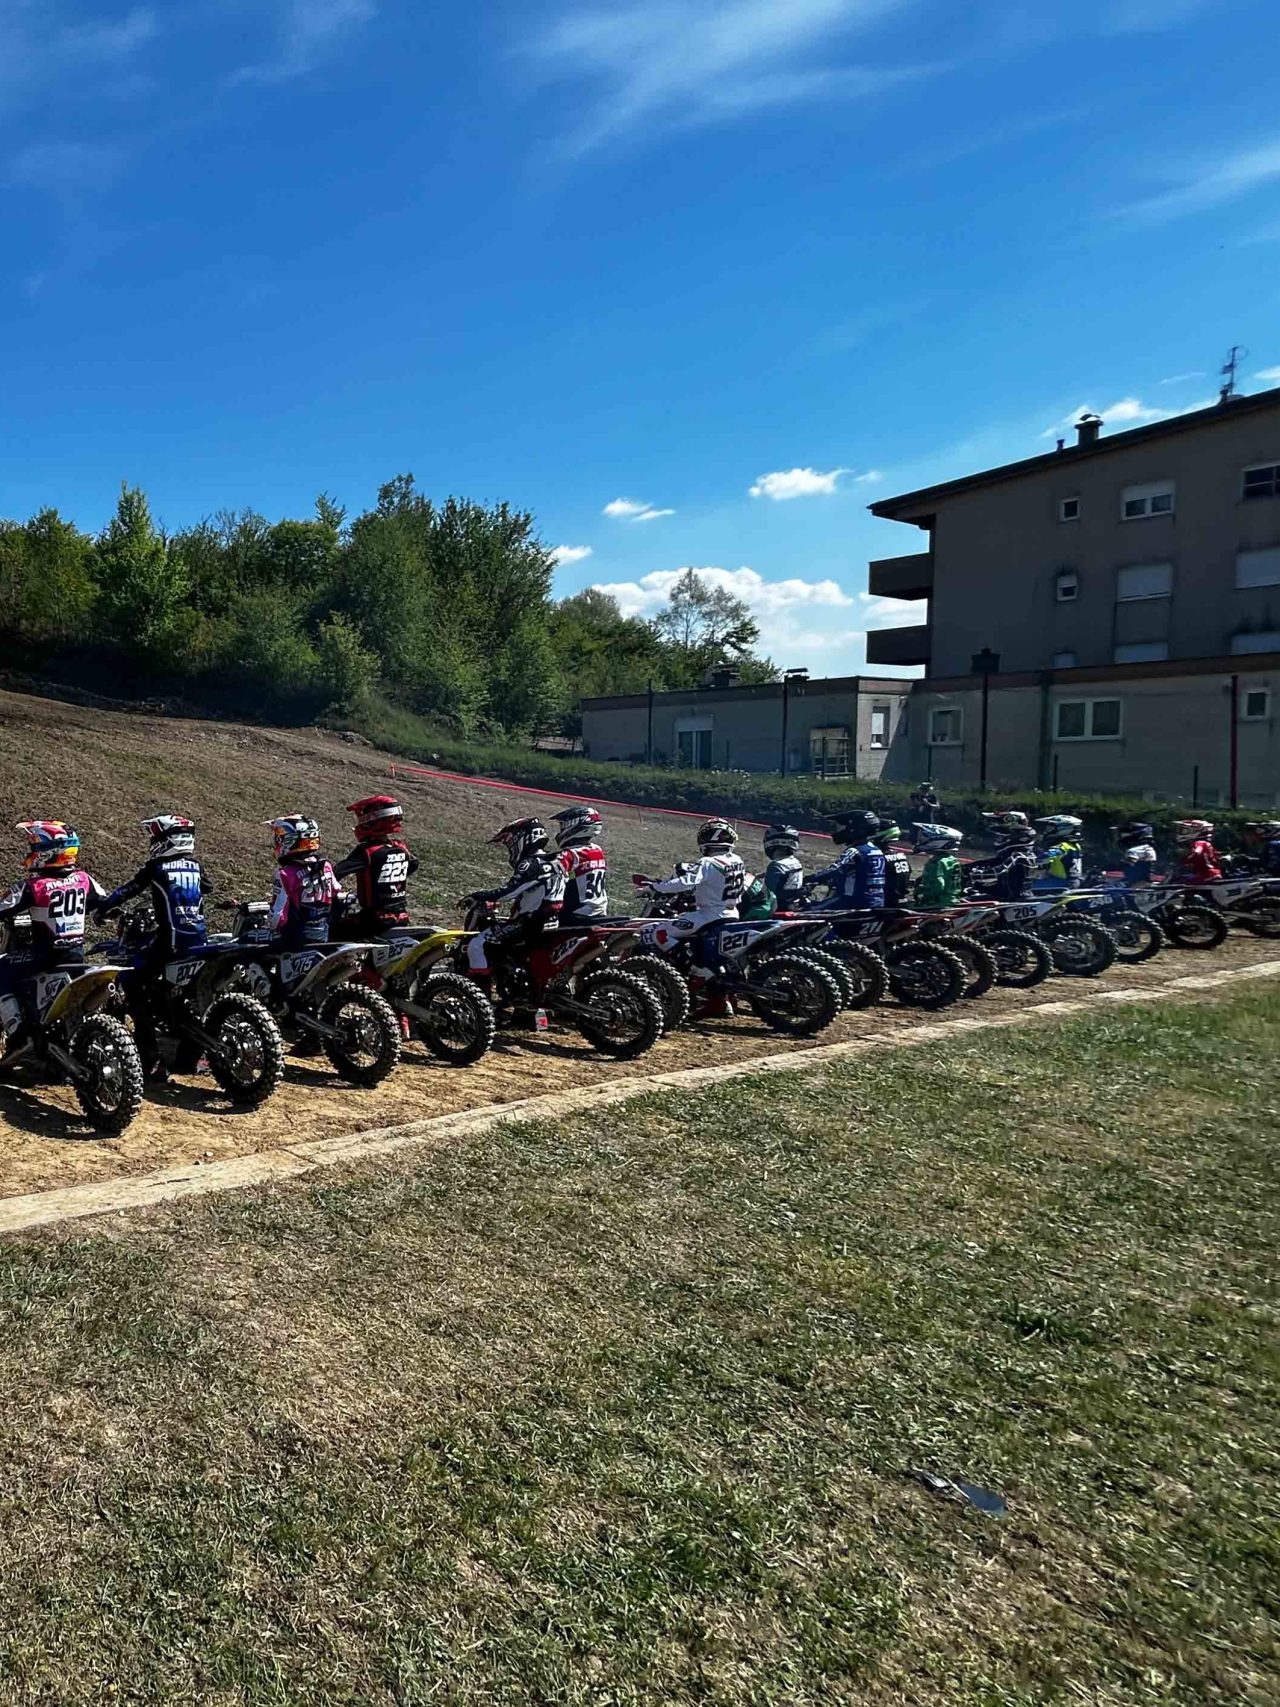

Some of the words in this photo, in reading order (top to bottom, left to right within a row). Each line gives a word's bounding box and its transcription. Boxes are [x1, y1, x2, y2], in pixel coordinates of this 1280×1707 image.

[377, 861, 409, 883] 223
[48, 887, 85, 918] 203
[1014, 906, 1037, 919] 205
[723, 932, 750, 952] 221
[293, 954, 316, 973] 275
